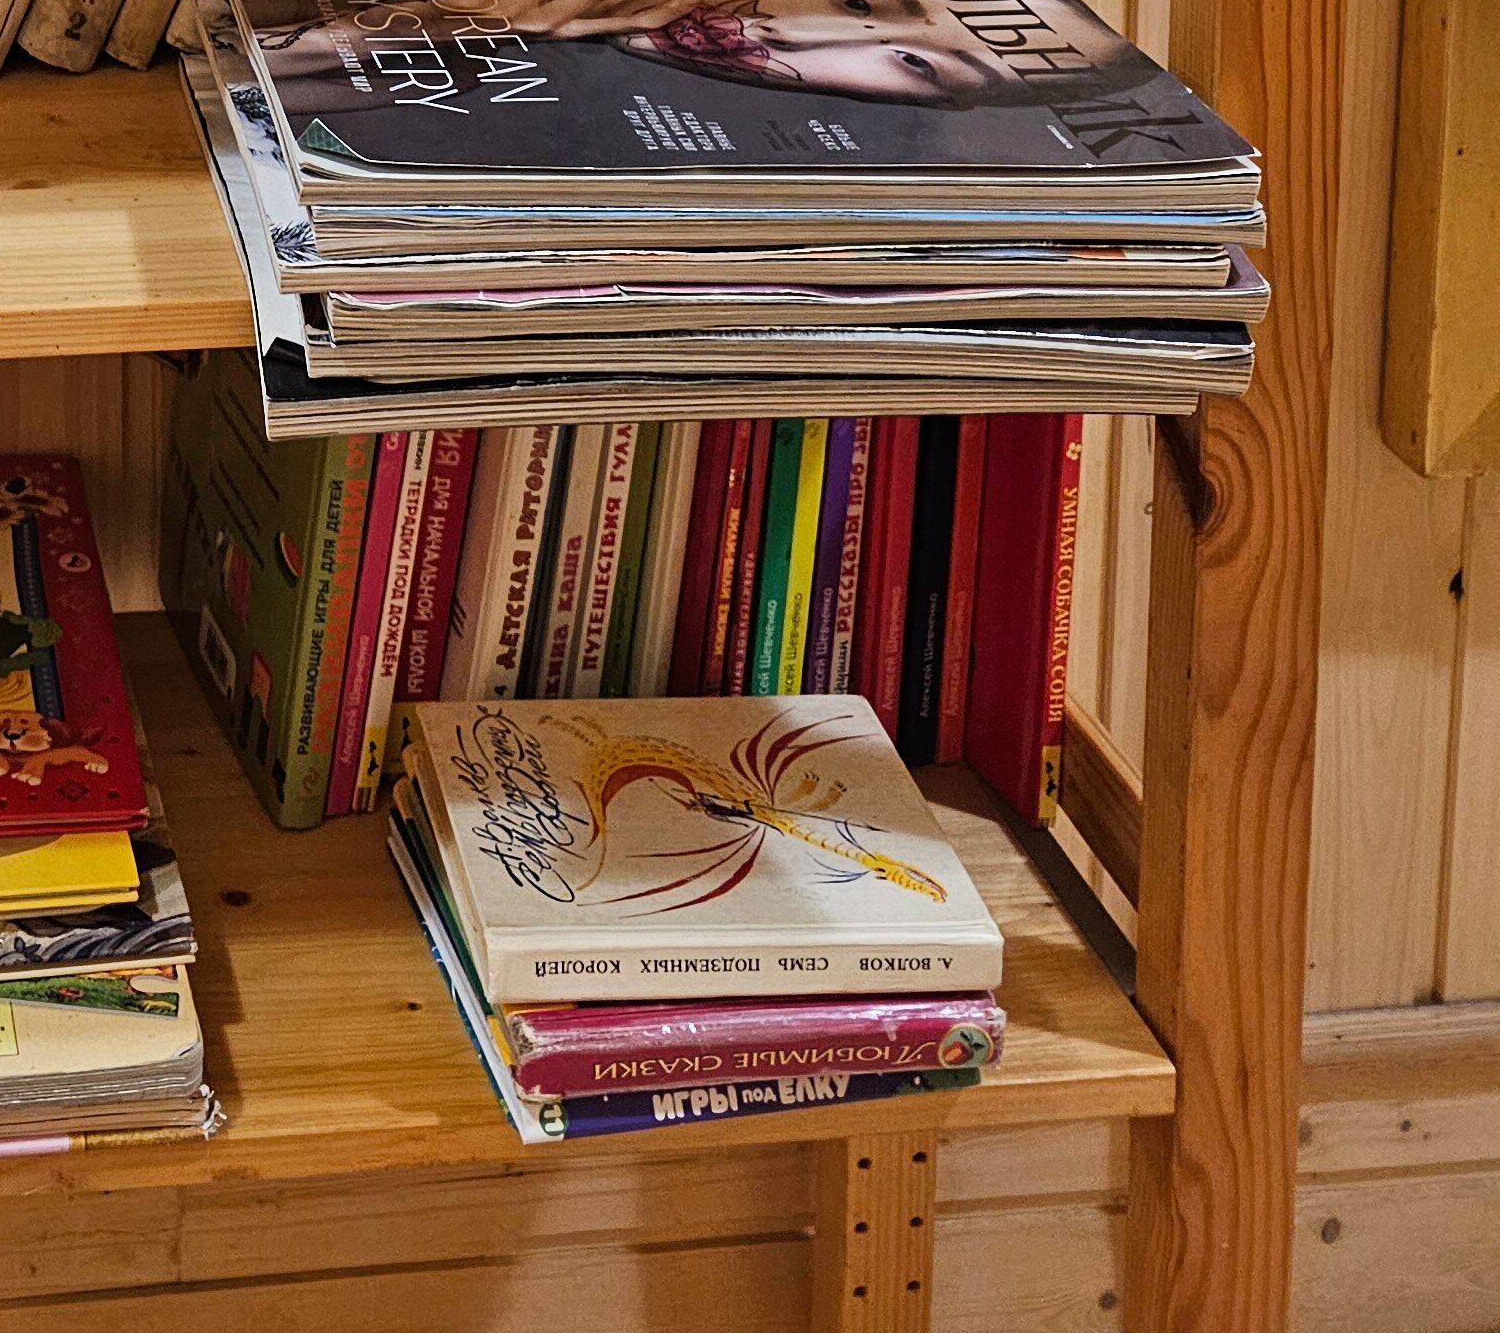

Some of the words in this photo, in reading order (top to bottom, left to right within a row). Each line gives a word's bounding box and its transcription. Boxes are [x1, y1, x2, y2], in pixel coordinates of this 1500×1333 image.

[323, 479, 346, 532] ДЕТЕЙ
[396, 479, 423, 560] ТЕТРАДКИ
[429, 475, 453, 511] ДЛЯ
[1058, 486, 1078, 560] УМНАЯ
[320, 537, 337, 573] ДЛЯ
[390, 564, 409, 601] ПОД
[411, 515, 449, 622] НАЧАЛЬНОЙ
[579, 496, 623, 670] ПУТЕШЕСТВИЯ
[312, 578, 332, 623] ИГРЫ
[494, 548, 534, 670] ДЕТСКАЯ
[784, 592, 805, 660] Шевченко
[815, 587, 834, 655] Шевченко
[922, 593, 940, 660] Шевченко
[1050, 566, 1073, 662] СОБАЧКА
[377, 602, 405, 678] ДОЖДЁМ
[400, 628, 432, 694] ШКОЛЫ
[759, 599, 777, 668] Шевченко
[295, 628, 326, 755] РАЗВИВАЮЩИЕ
[918, 663, 934, 717] Алексей
[1047, 665, 1066, 723] СОНЯ
[534, 959, 619, 977] КОРОЛЕЙ
[640, 956, 759, 973] ПОДЗЕМНЫХ
[777, 956, 828, 971] СЕМЬ
[858, 956, 930, 970] ВОЛКОВ
[936, 956, 952, 969] А.
[592, 1054, 722, 1080] СКАЗКИ
[734, 1038, 936, 1076] ЛЮБИМЫЕ
[651, 1083, 739, 1122] ИГРЫ
